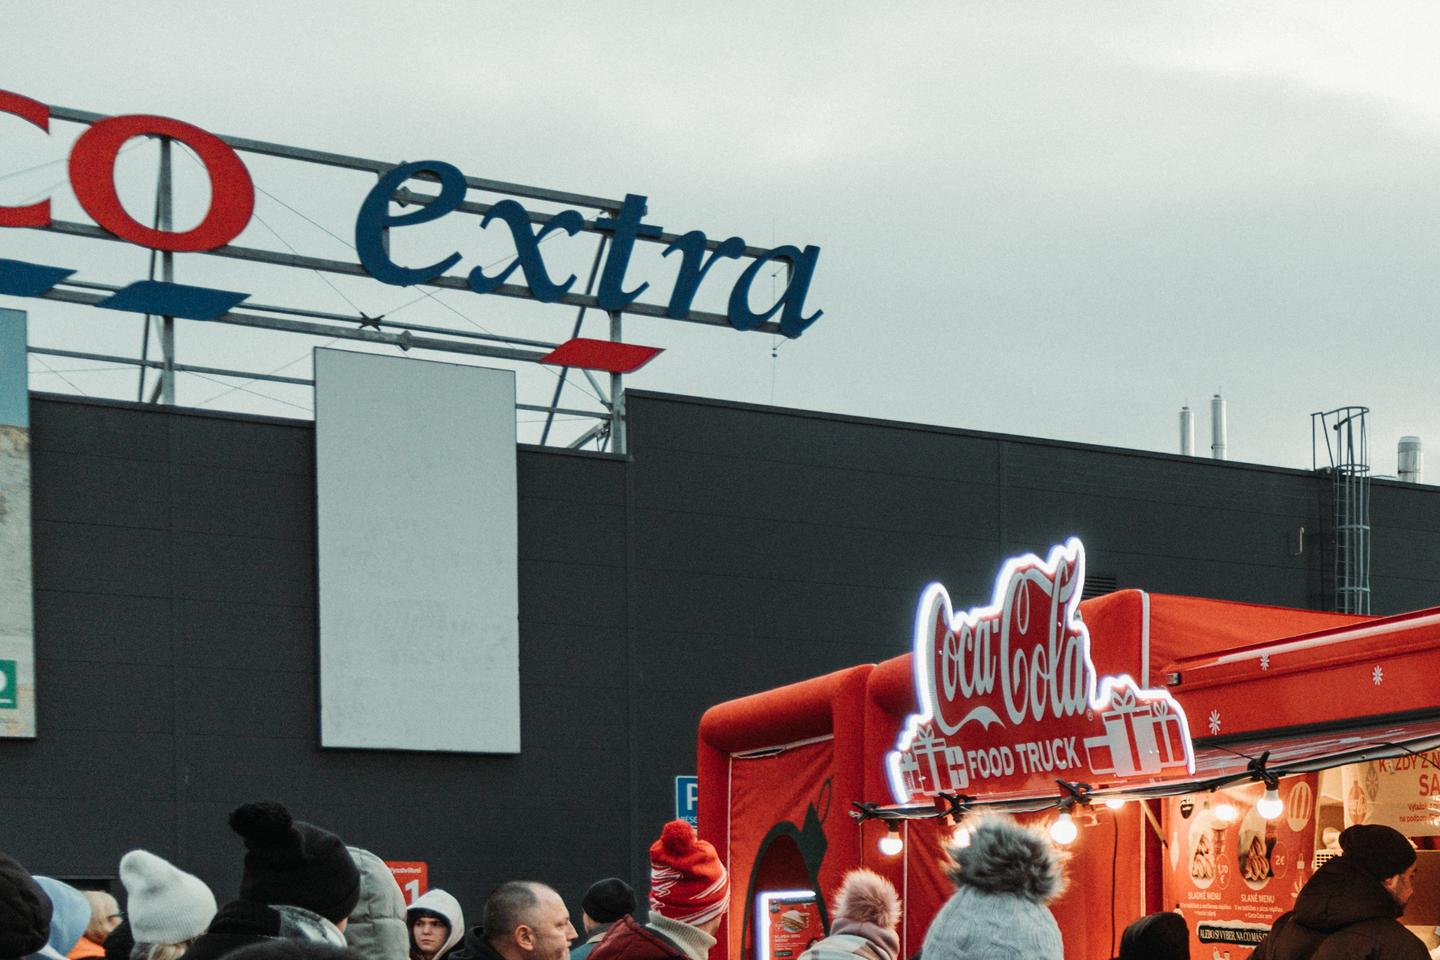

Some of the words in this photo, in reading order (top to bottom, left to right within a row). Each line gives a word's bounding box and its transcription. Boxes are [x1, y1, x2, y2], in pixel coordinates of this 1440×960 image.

[356, 160, 823, 339] extra
[967, 745, 1013, 780] FOOD
[1015, 736, 1082, 771] TRUCK
